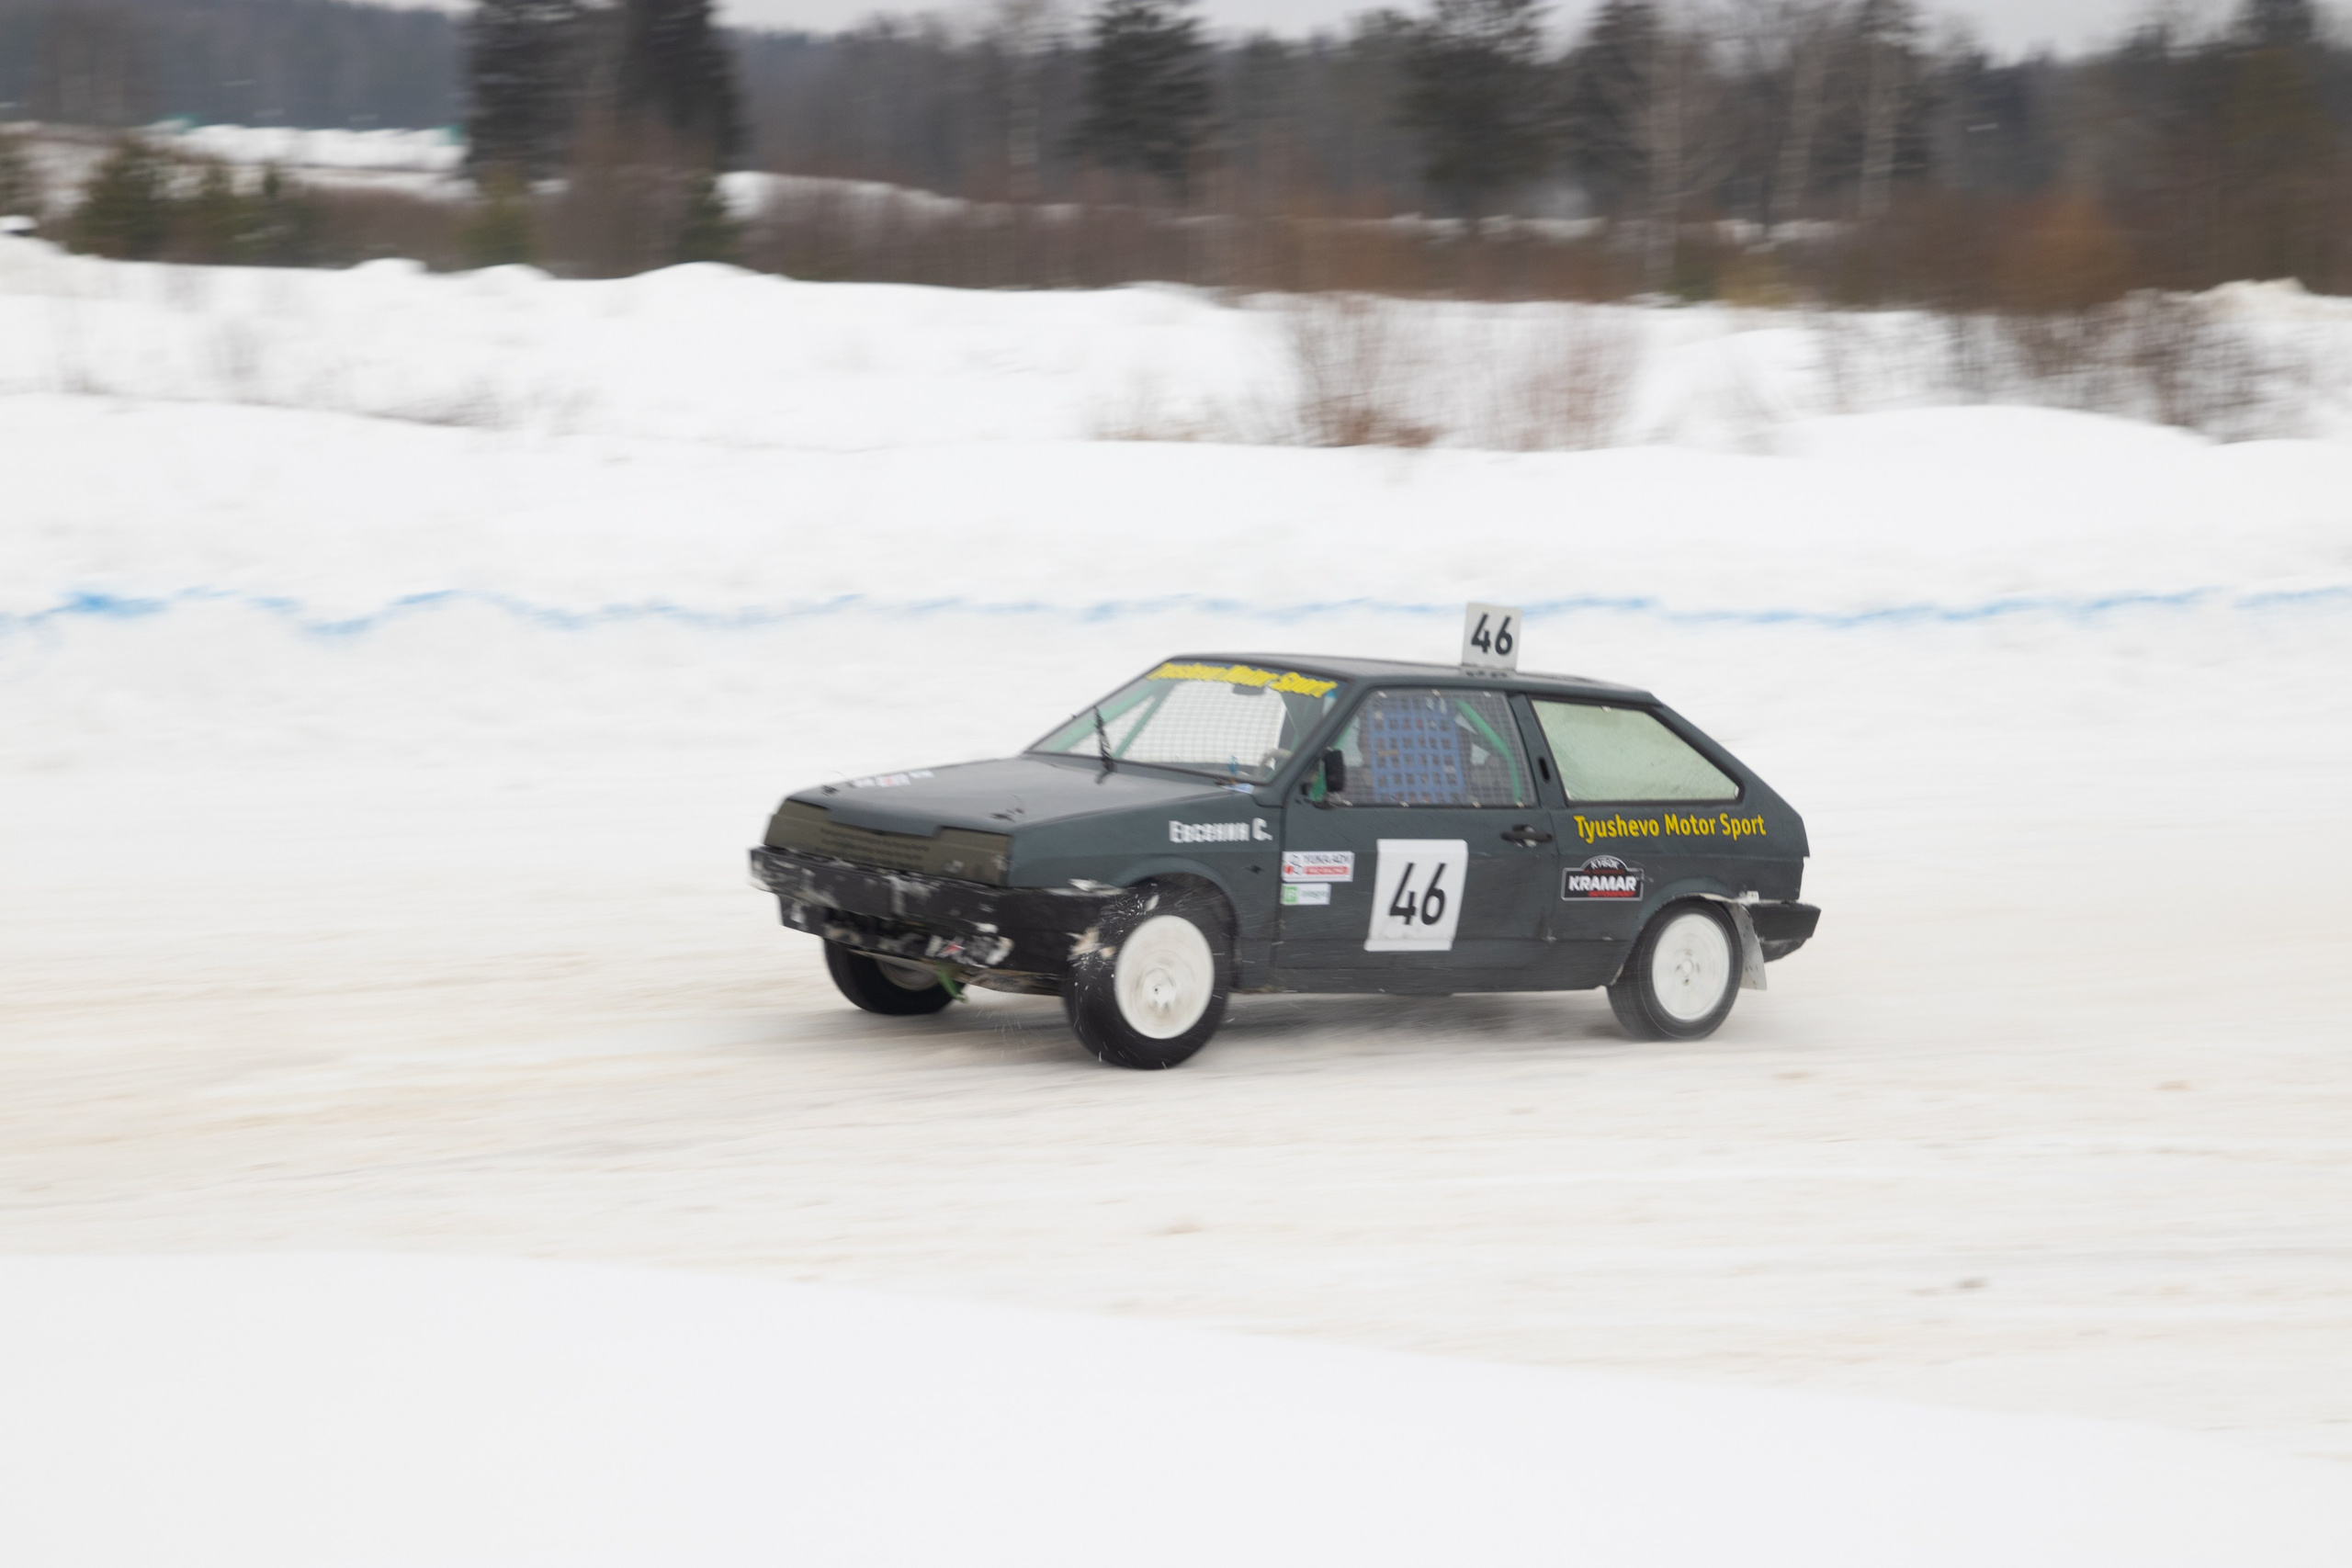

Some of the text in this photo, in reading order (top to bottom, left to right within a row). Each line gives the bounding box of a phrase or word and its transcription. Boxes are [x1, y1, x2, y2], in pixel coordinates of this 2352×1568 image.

[1471, 613, 1513, 656] 46
[1573, 812, 1767, 844] Tyushevo Motor Sport
[1388, 862, 1446, 926] 46
[1567, 874, 1637, 892] KRAMAR
